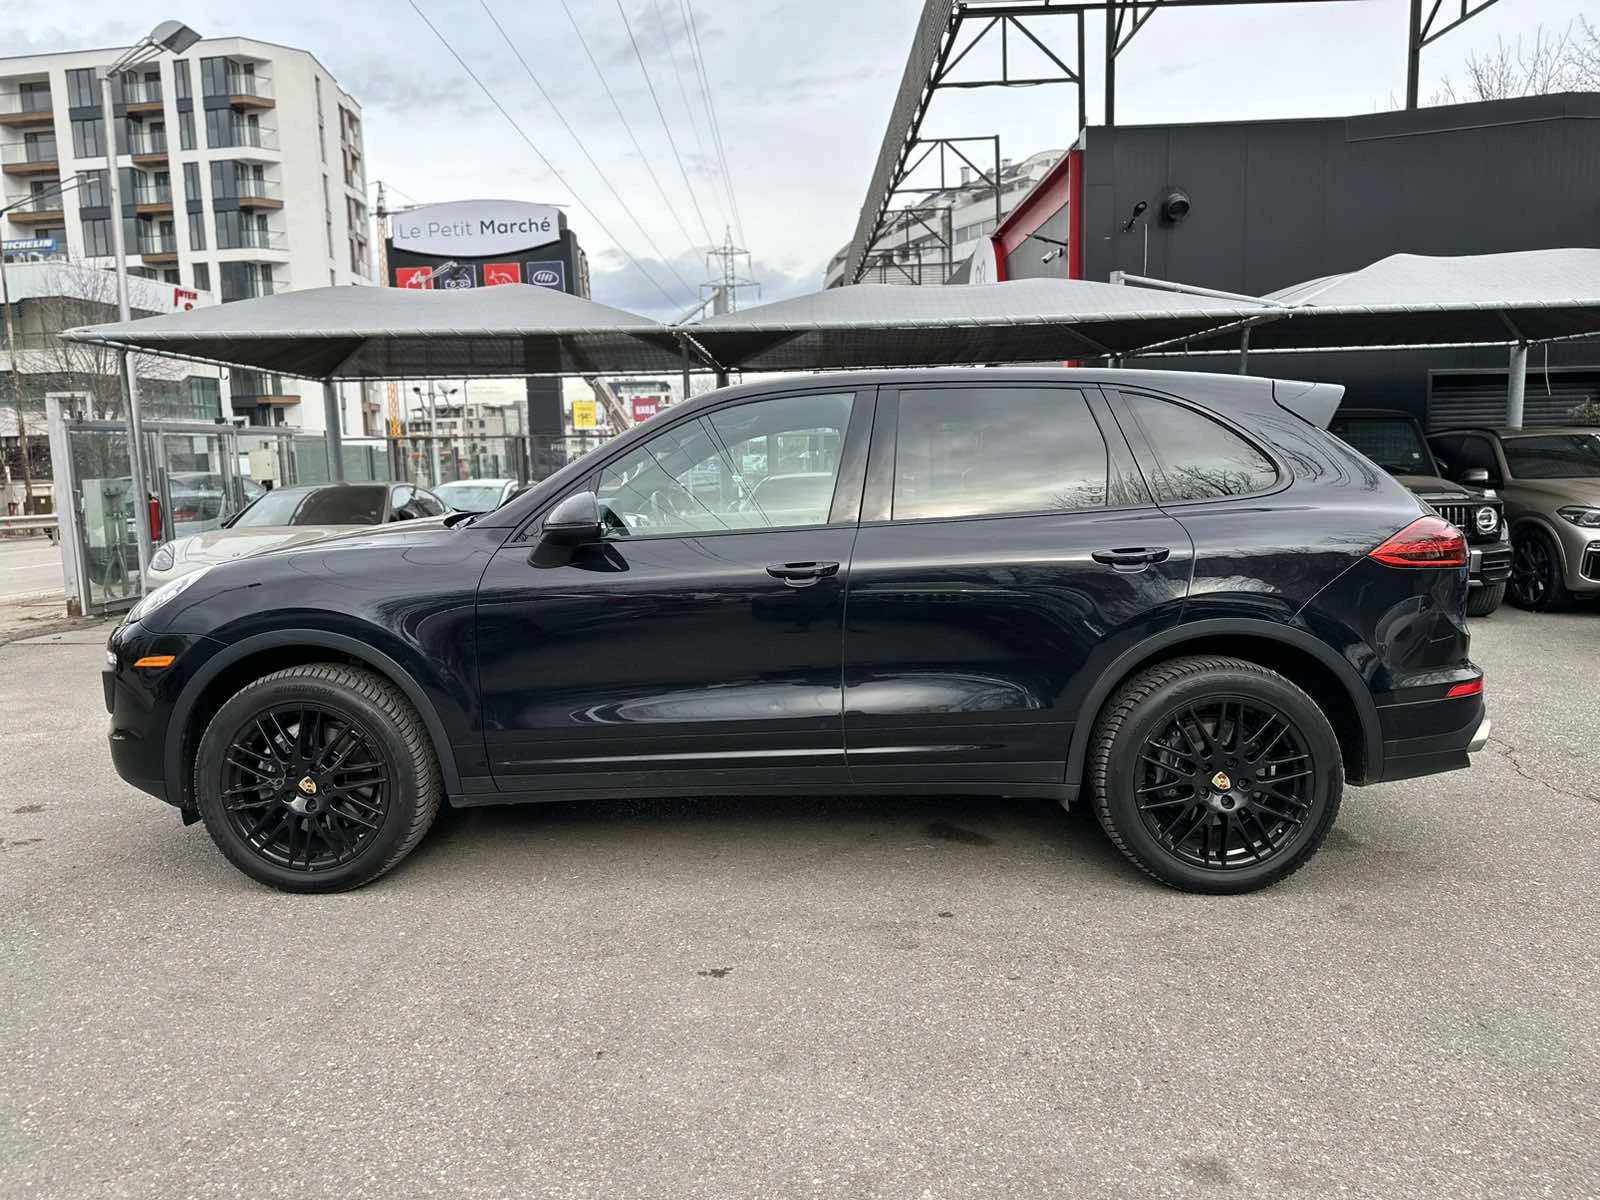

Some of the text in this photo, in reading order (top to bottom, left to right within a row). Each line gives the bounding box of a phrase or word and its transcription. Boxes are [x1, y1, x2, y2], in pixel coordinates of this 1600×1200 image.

[399, 217, 551, 239] Le Petit Marché
